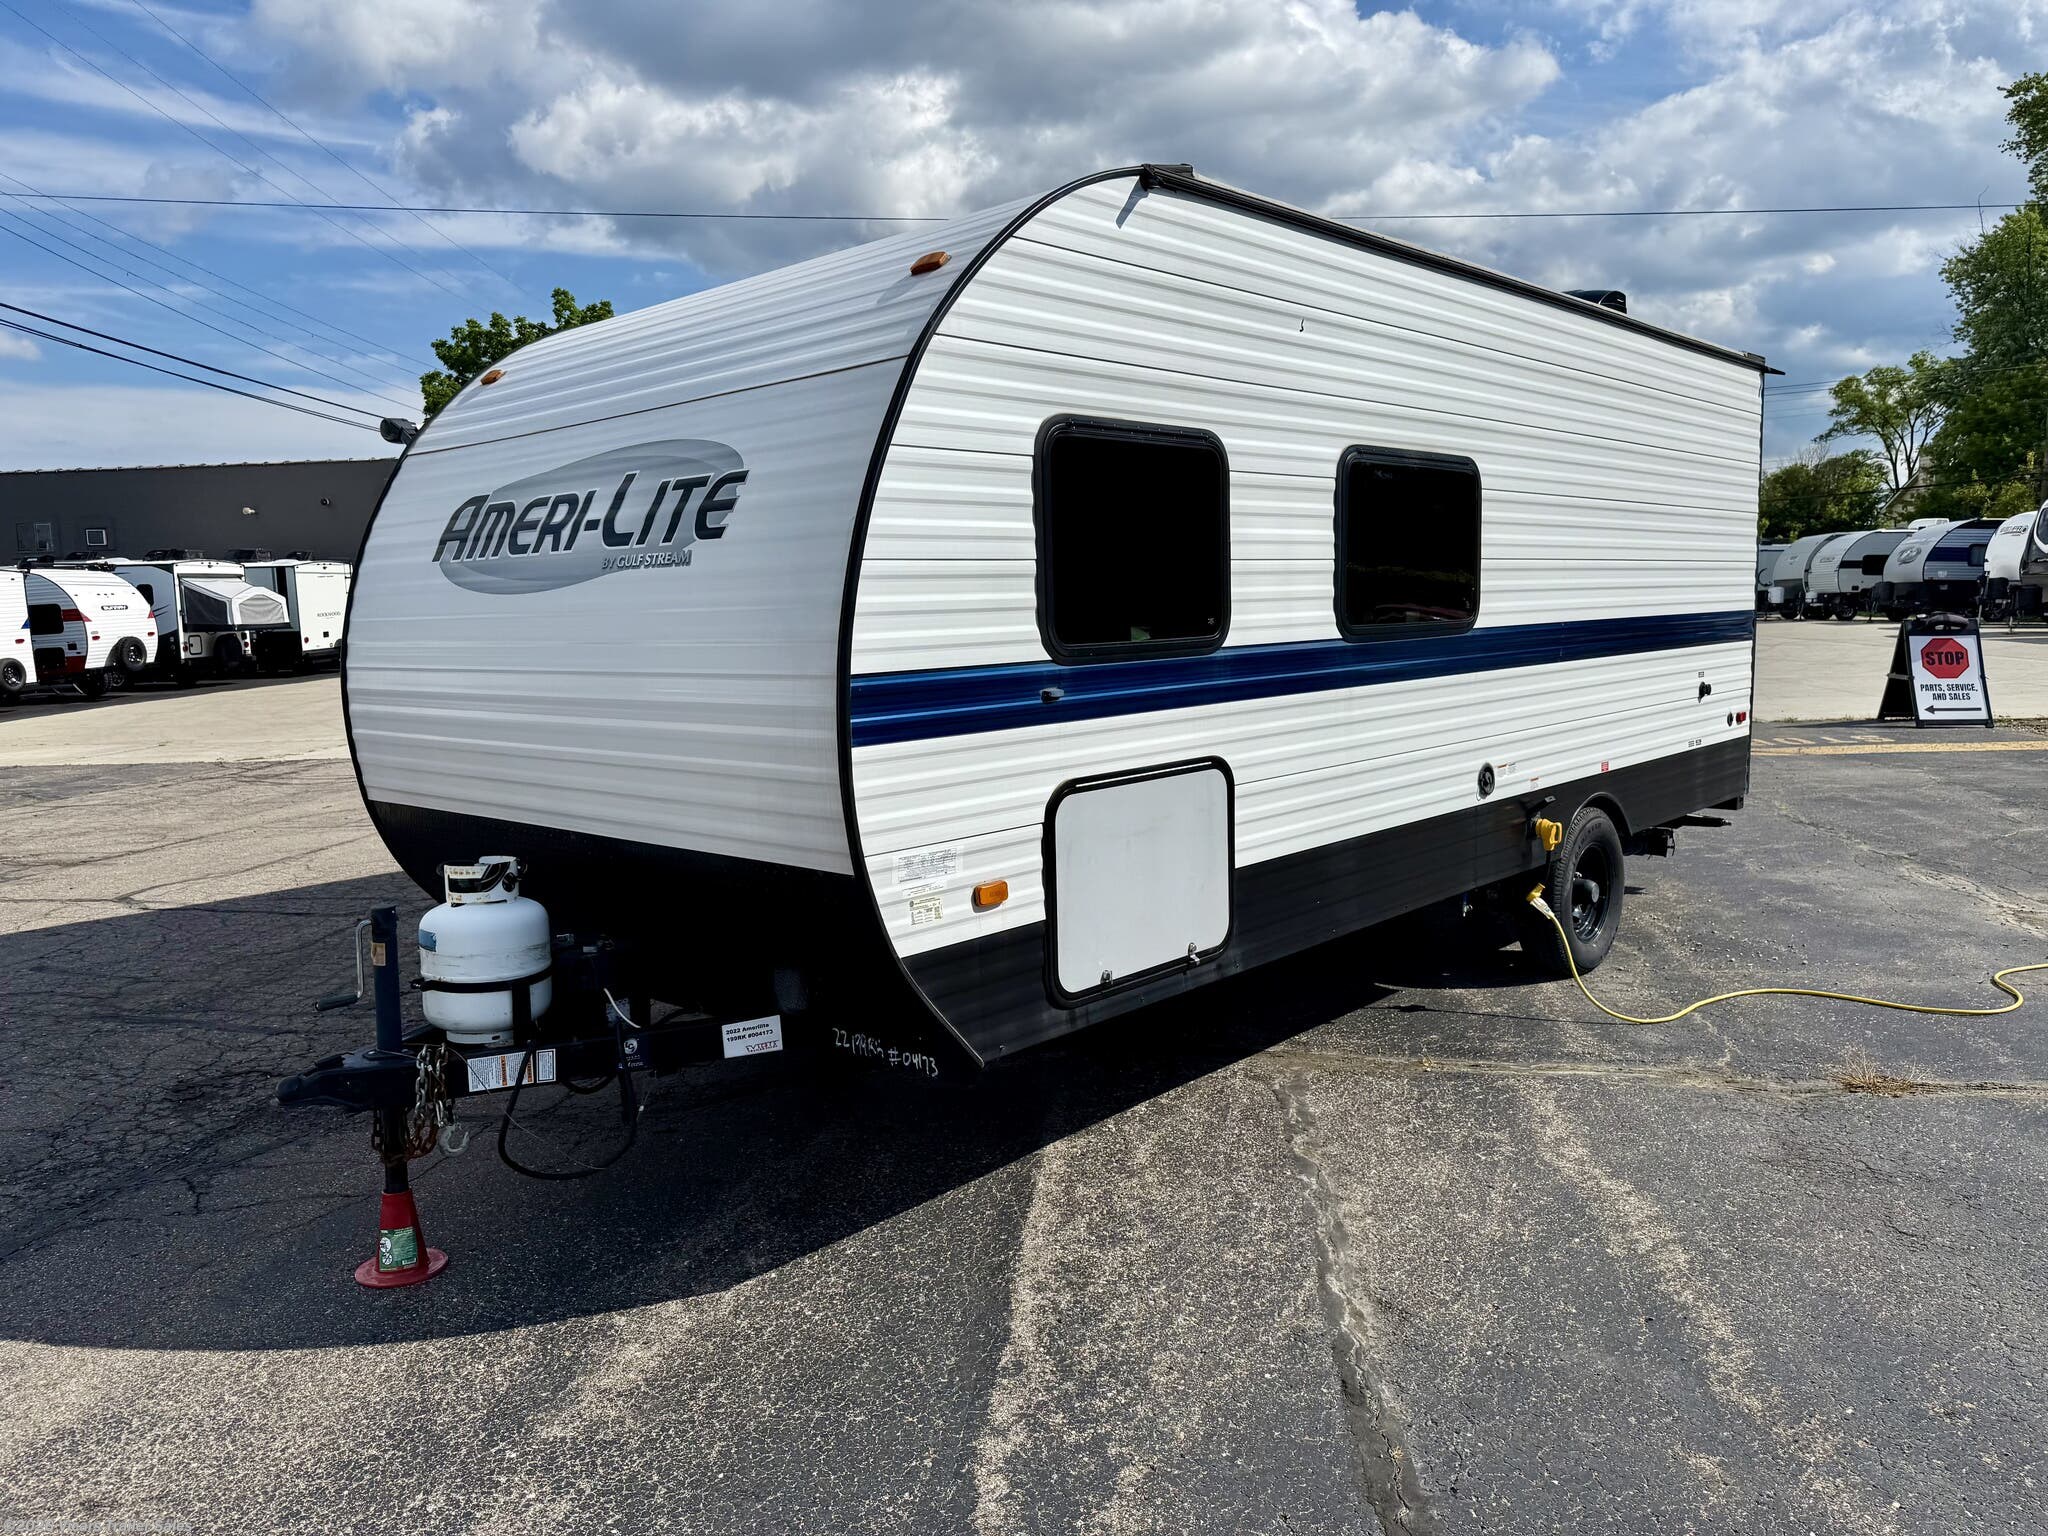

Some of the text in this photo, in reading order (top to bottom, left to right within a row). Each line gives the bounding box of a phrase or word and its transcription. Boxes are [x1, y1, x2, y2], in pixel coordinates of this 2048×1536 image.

[602, 550, 692, 569] BY GULF STREAM
[1925, 651, 1964, 666] STOP
[1920, 683, 1978, 692] PARTS, SERVICE,
[1932, 693, 1971, 701] AND SALES
[832, 1027, 850, 1048] 22
